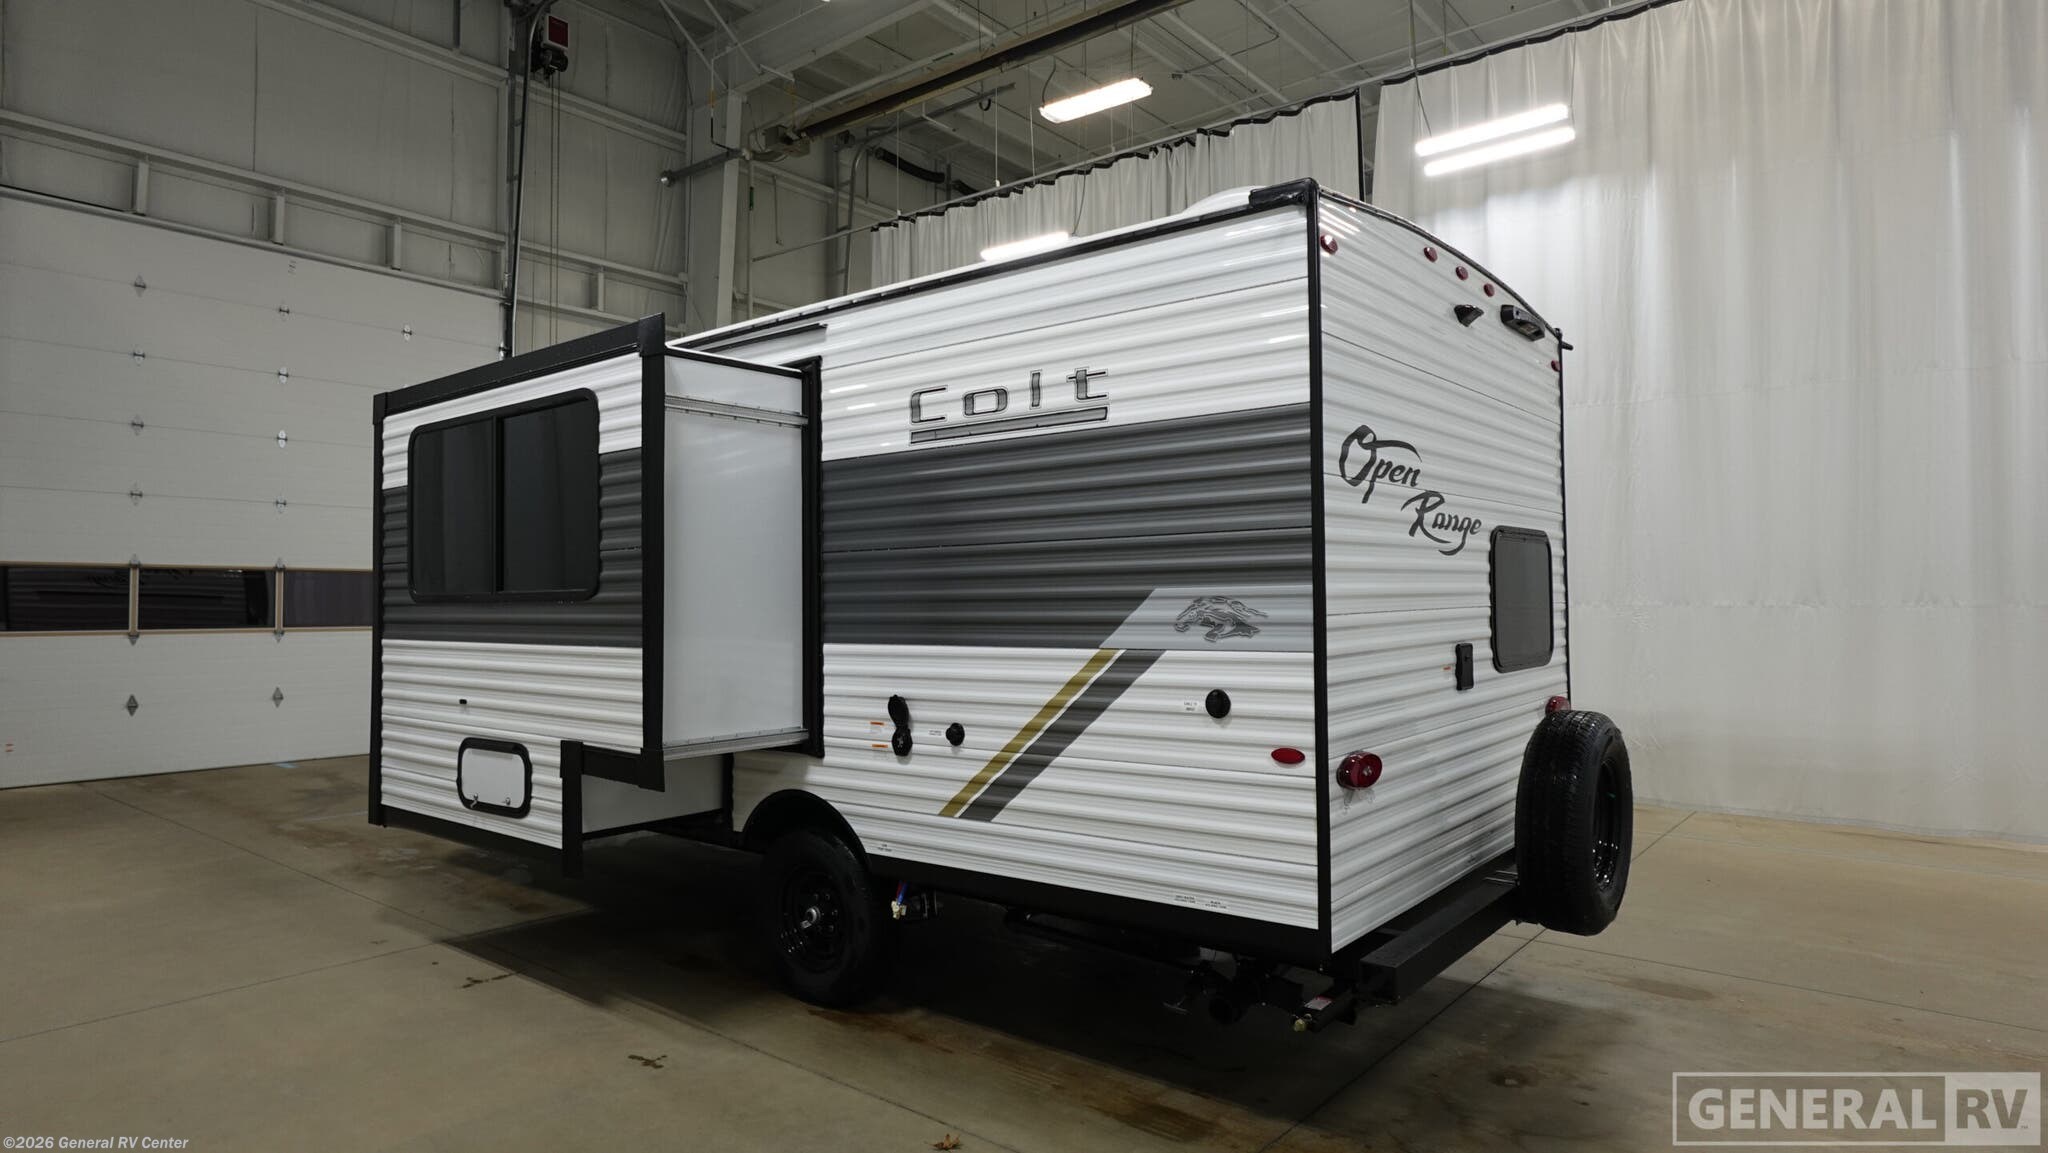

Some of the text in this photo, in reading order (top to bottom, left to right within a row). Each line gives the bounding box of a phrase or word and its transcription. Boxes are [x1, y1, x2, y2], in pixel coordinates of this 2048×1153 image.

[910, 368, 1108, 424] Colt
[1339, 425, 1422, 504] Open
[1401, 490, 1482, 556] Range
